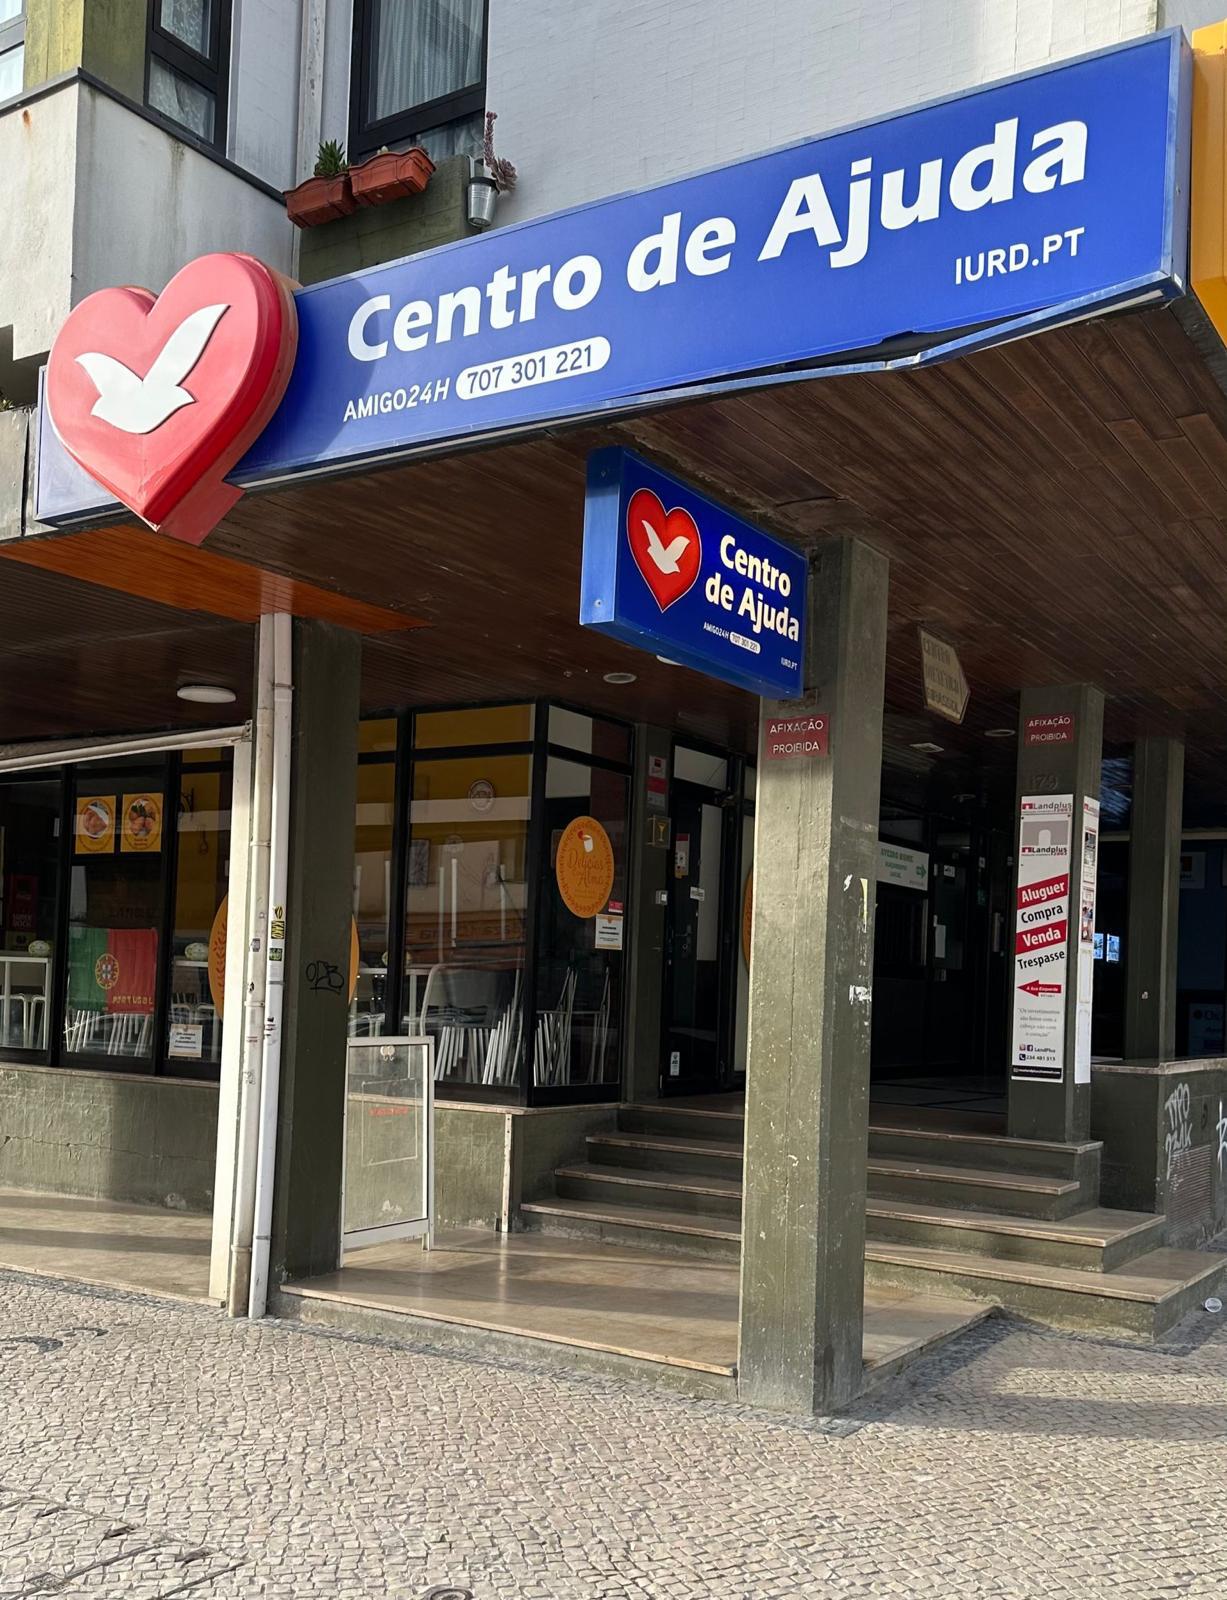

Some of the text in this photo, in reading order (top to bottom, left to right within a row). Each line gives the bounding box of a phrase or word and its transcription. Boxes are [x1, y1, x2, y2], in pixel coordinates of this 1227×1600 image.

[347, 117, 1088, 363] Centro de Ajuda
[955, 227, 1086, 285] IURD.PT
[343, 345, 592, 422] AMIGO24H 707 301 221
[720, 534, 792, 597] Centro
[705, 572, 800, 642] de Ajuda
[703, 621, 730, 640] AMIGO24H
[1028, 716, 1071, 727] AFIXAÇÃO
[1030, 732, 1067, 742] PROIBIDA
[772, 741, 820, 755] PROIBIDA
[1033, 802, 1072, 811] Landplus
[1032, 846, 1068, 854] Landplus
[1021, 882, 1065, 903] Aluguer
[1021, 905, 1063, 923] Compra
[1022, 927, 1061, 947] Venda
[1017, 951, 1065, 970] Trespasse
